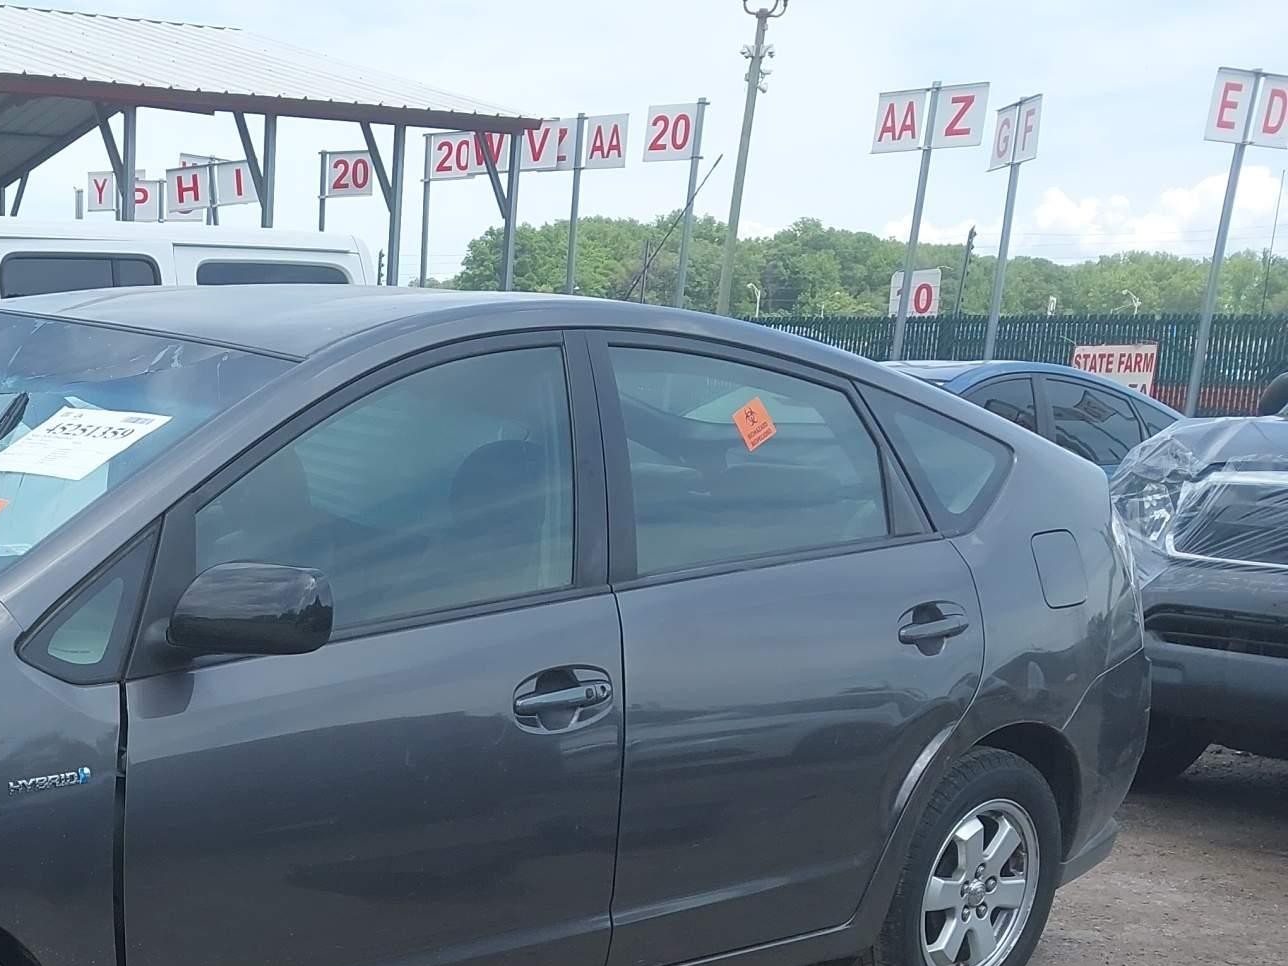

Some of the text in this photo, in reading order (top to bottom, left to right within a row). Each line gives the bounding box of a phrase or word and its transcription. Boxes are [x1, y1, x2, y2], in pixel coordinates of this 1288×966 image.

[877, 101, 916, 142] AA
[944, 95, 975, 136] Z
[1217, 82, 1243, 129] E
[1262, 88, 1288, 134] D
[527, 128, 551, 162] V
[589, 124, 622, 160] AA
[647, 114, 691, 151] 20
[997, 118, 1011, 158] G
[1023, 110, 1035, 151] F
[435, 140, 470, 172] 20
[473, 131, 505, 166] W
[177, 174, 199, 204] H
[332, 158, 369, 189] 20
[93, 179, 108, 204] Y
[1074, 353, 1155, 373] STATE FARM
[45, 423, 135, 440] 45251359
[8, 771, 78, 796] HYBRID
